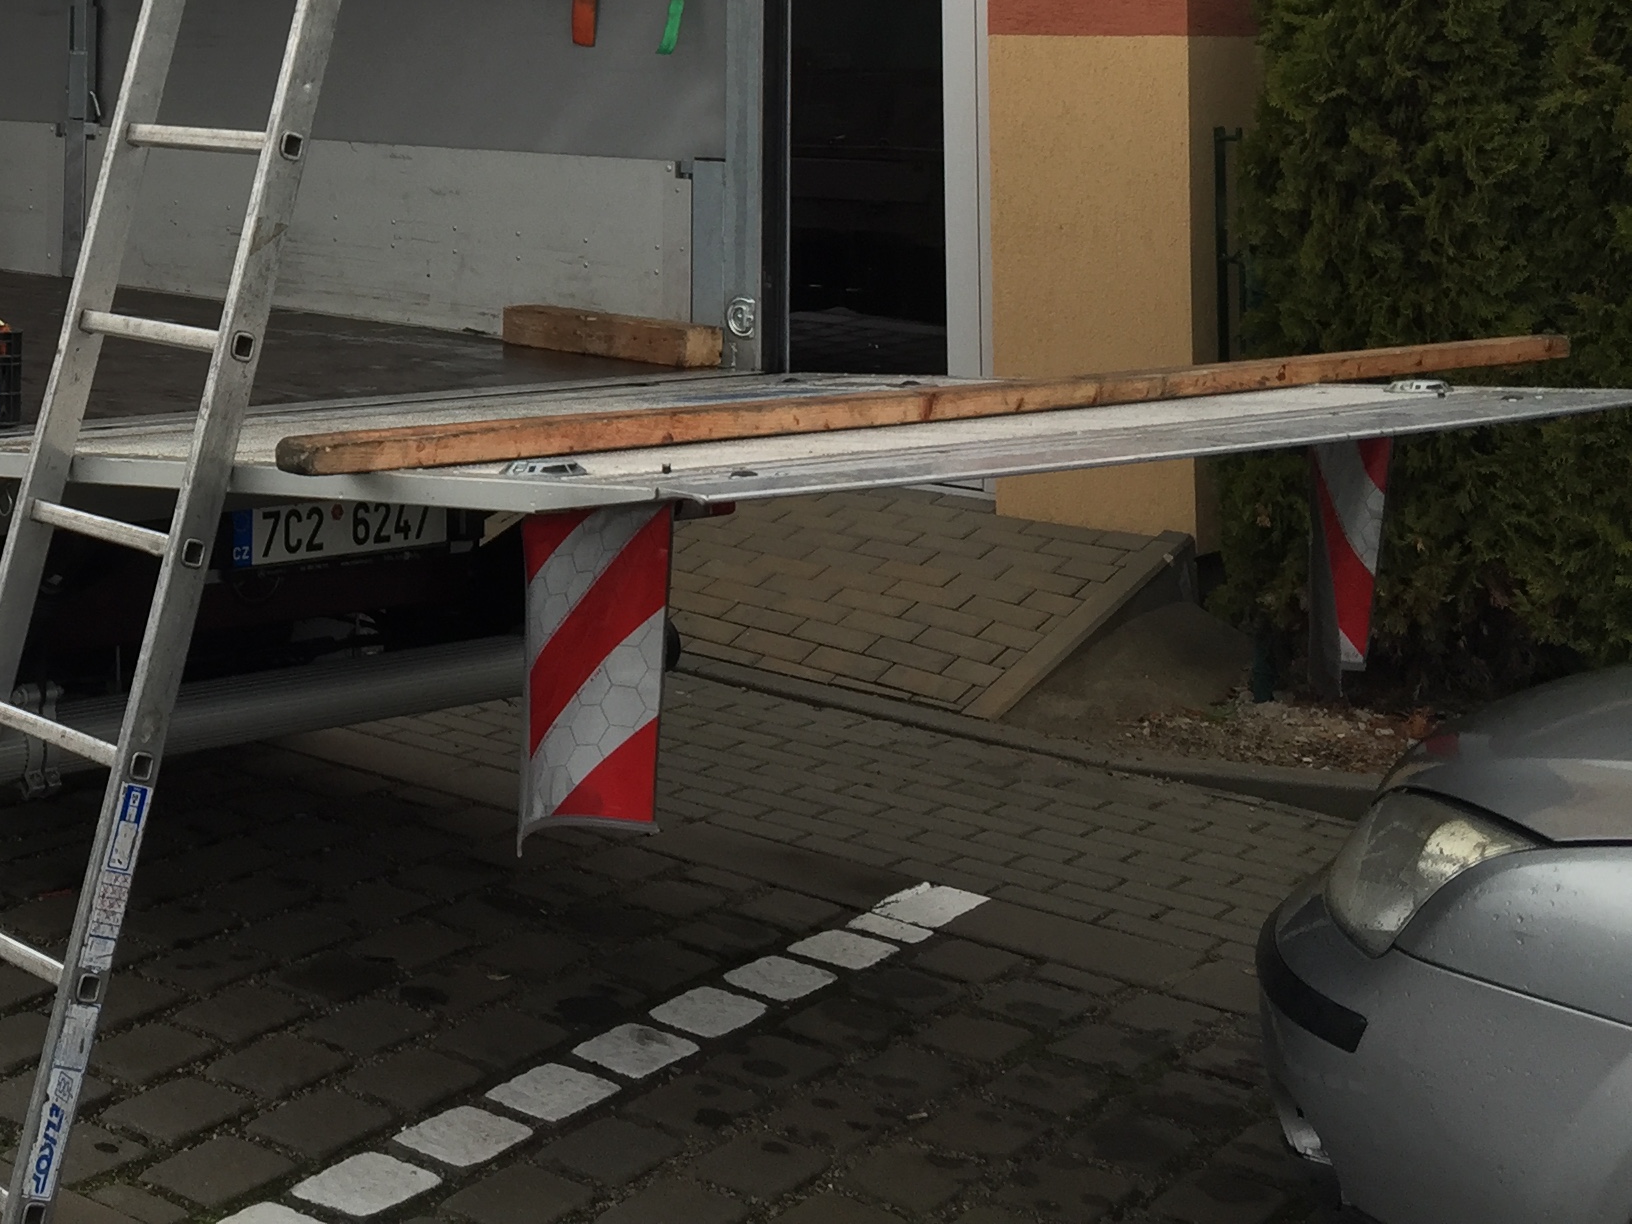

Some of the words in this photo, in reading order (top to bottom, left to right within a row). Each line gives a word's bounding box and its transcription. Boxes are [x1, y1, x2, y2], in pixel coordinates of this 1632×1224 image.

[262, 507, 324, 558] 7C2
[352, 502, 429, 545] 6247
[232, 545, 250, 561] CZ
